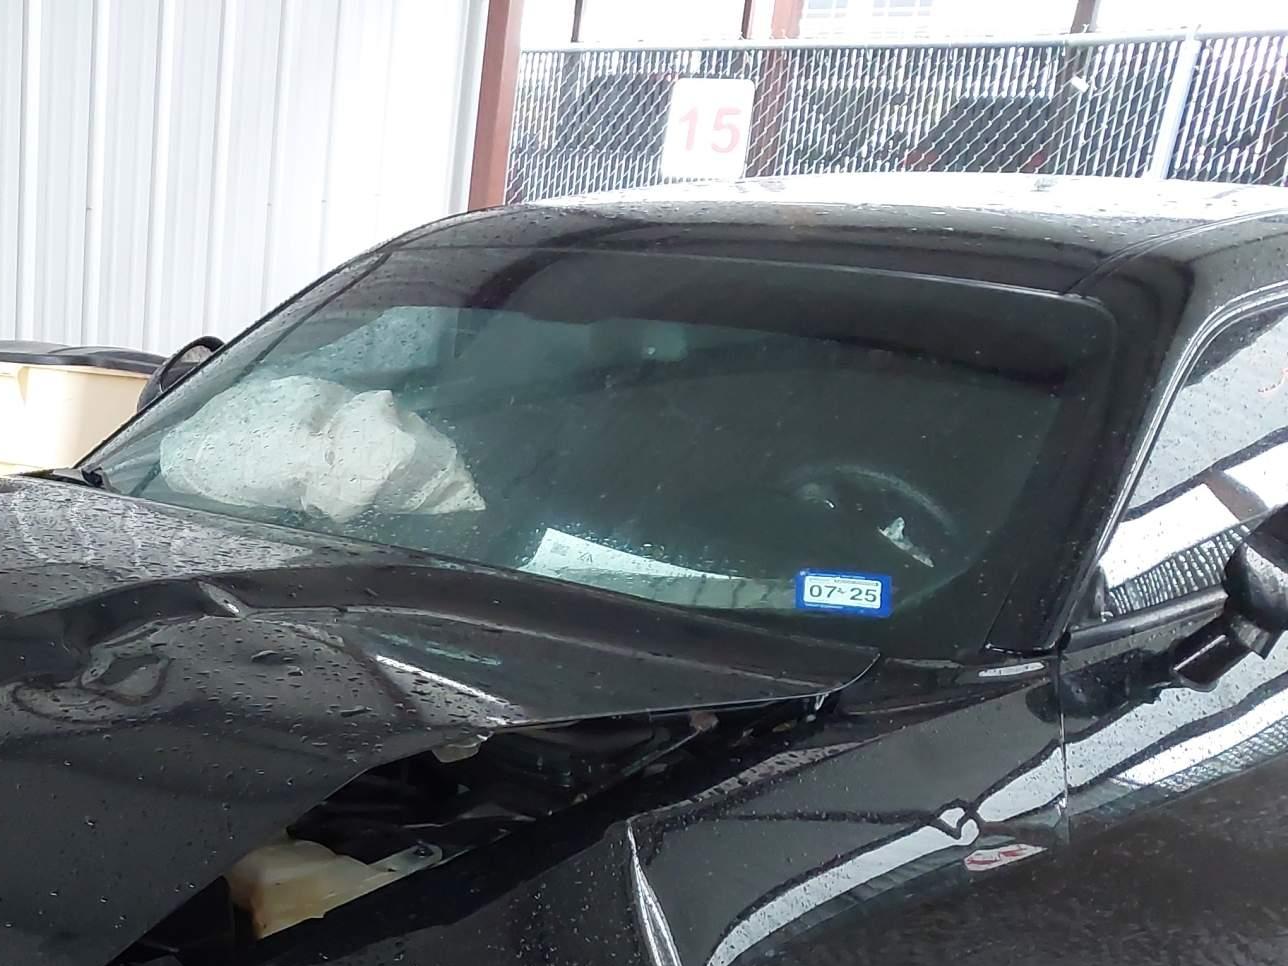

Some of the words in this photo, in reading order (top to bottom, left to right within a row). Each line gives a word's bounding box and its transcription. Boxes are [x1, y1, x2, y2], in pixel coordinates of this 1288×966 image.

[679, 106, 741, 154] 15
[809, 584, 836, 598] 07
[850, 587, 877, 603] 25
